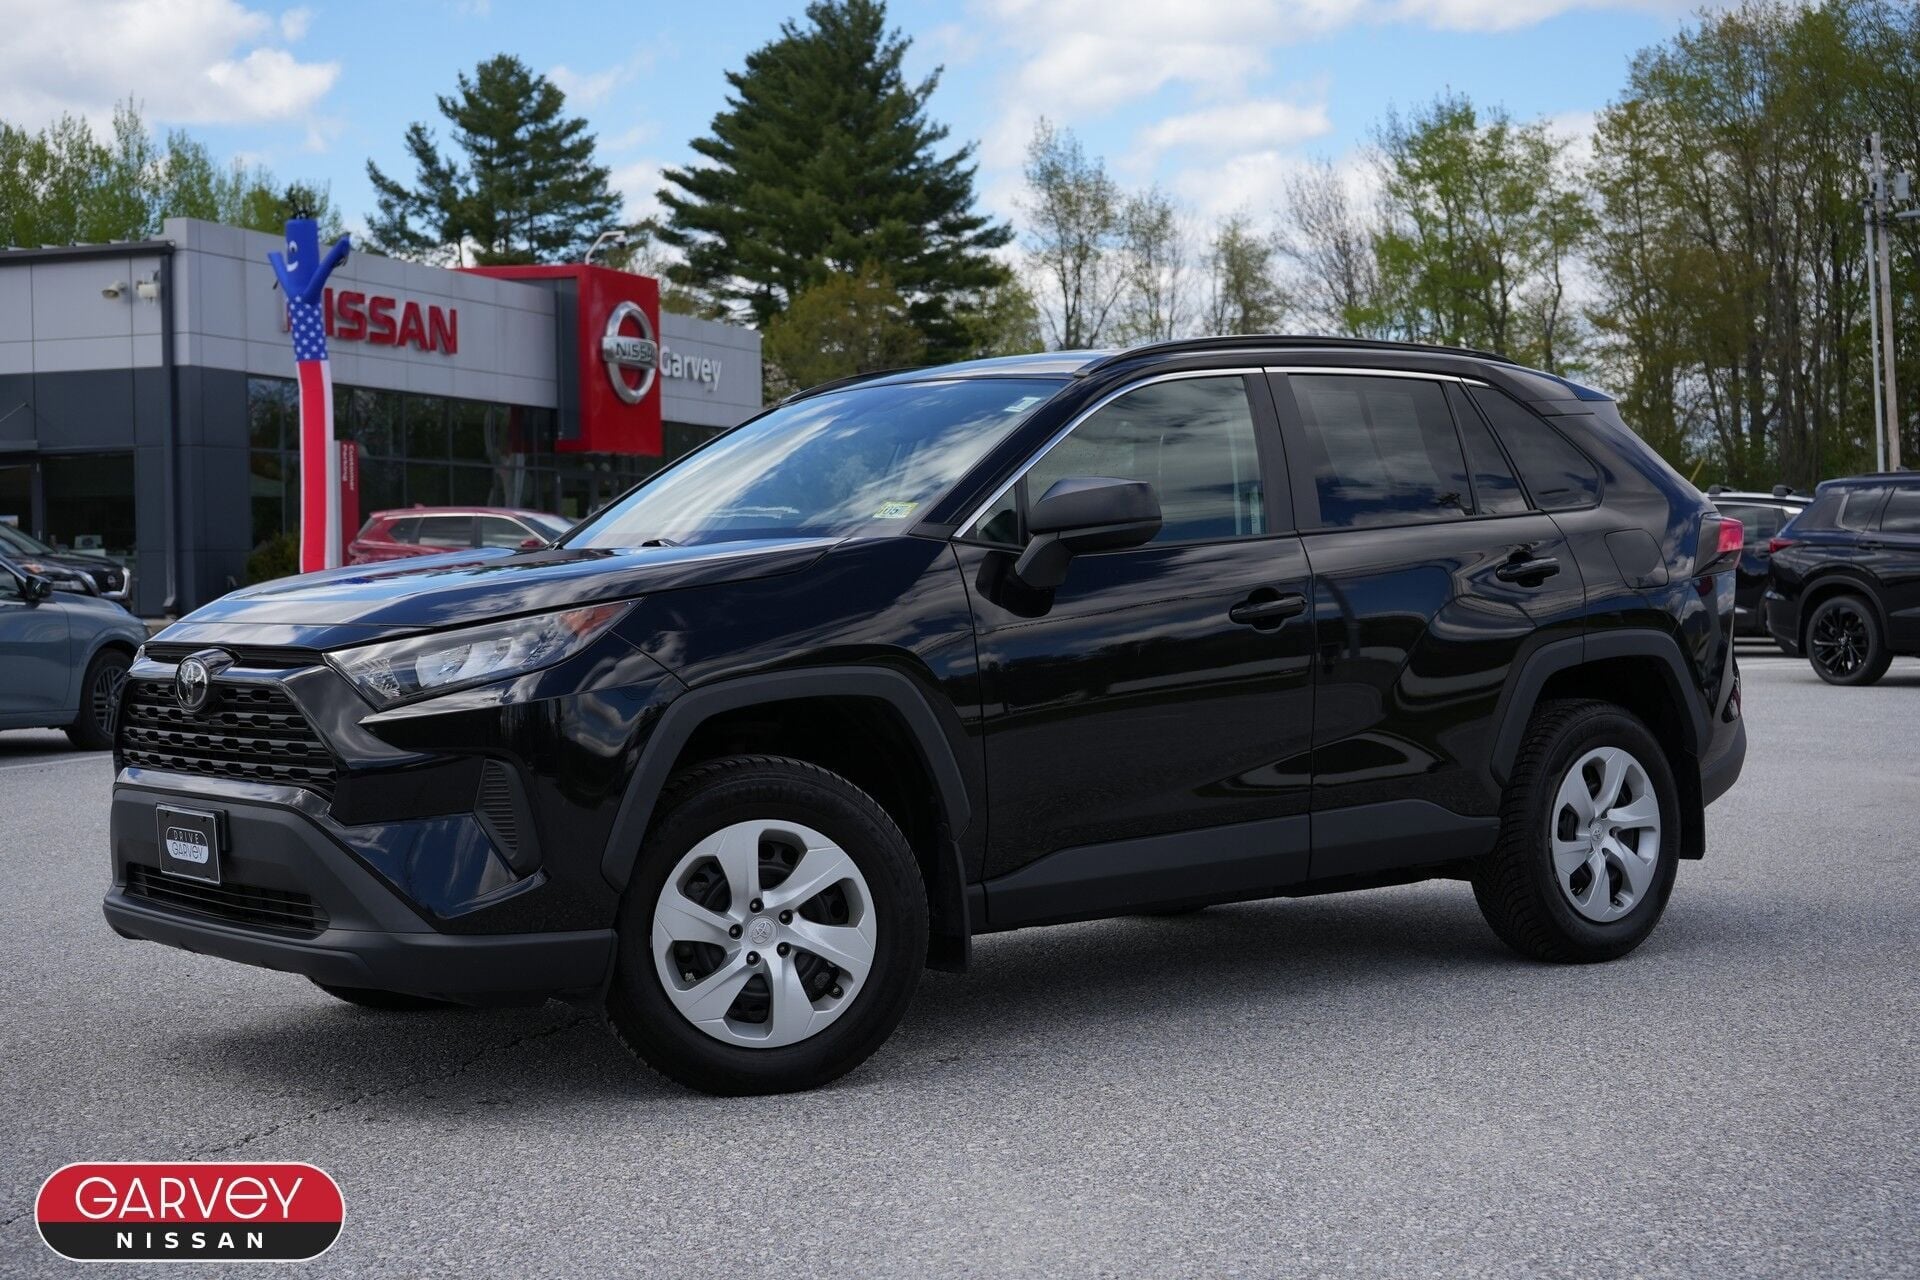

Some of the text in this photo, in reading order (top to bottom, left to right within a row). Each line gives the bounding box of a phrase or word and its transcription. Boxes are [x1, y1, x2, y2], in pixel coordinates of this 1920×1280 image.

[284, 287, 458, 355] ISSAN
[659, 346, 721, 391] Garvey
[173, 830, 199, 844] DRIVE
